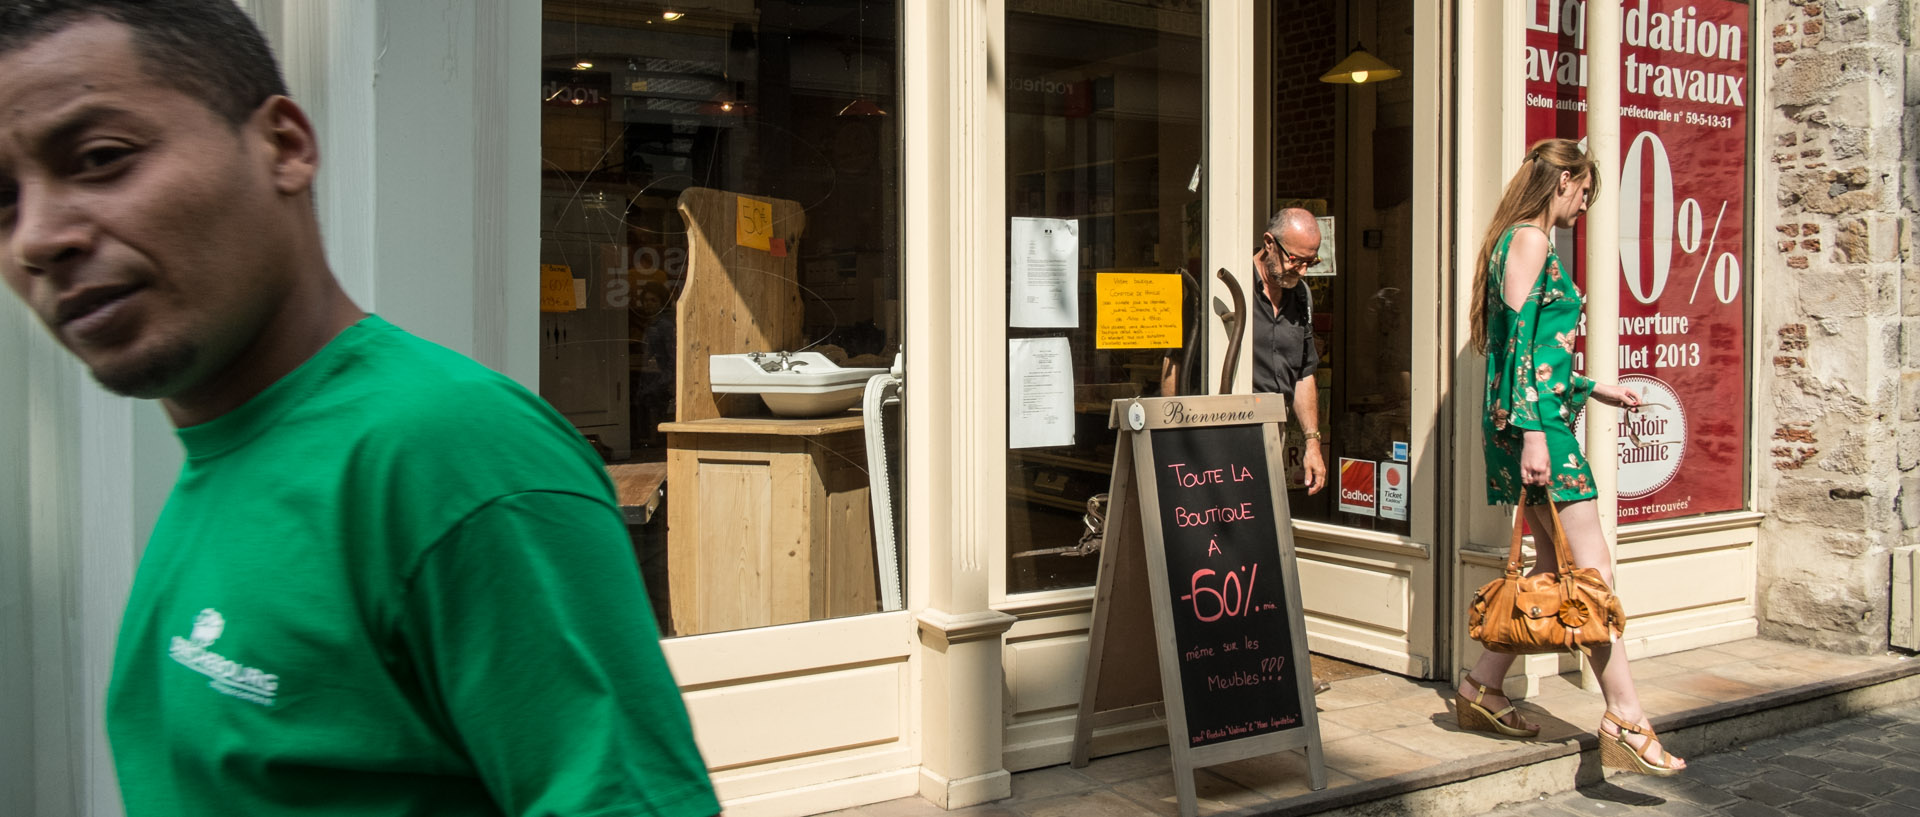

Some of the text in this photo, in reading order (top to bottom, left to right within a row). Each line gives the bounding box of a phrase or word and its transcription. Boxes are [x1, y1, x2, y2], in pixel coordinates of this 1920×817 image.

[1625, 53, 1744, 107] travaux
[1526, 93, 1553, 109] Selon
[1686, 112, 1732, 129] 59-5-13-31
[1655, 342, 1700, 368] 2013
[1162, 401, 1255, 425] Bienvenue
[1168, 463, 1254, 488] TOUTE LA
[1341, 488, 1374, 503] Cadhoc
[1385, 491, 1402, 500] Ticket
[1245, 635, 1260, 650] les
